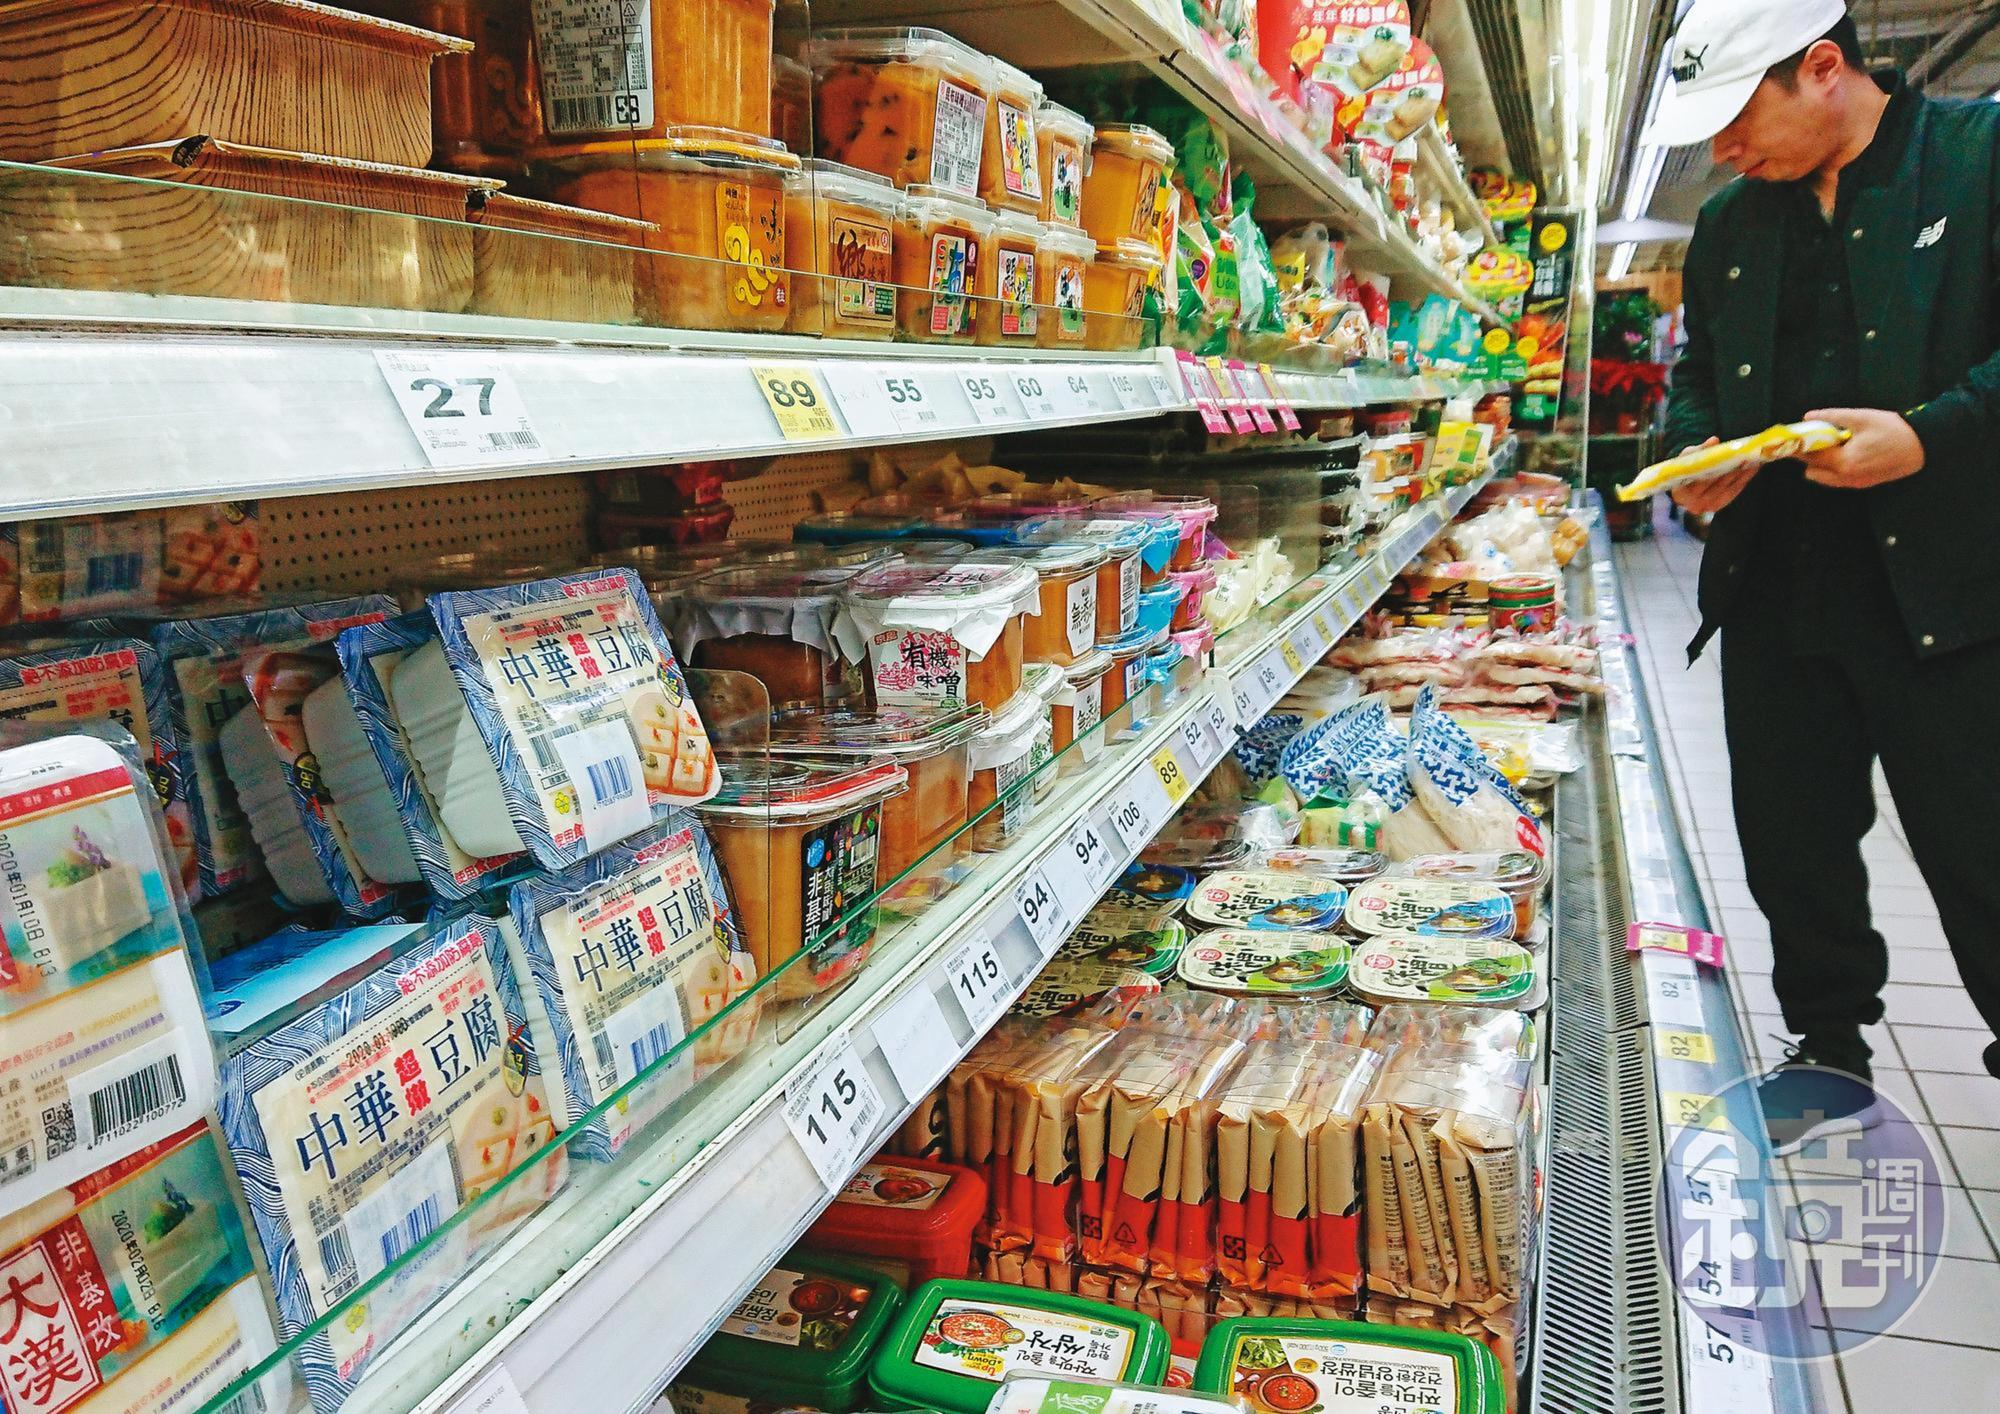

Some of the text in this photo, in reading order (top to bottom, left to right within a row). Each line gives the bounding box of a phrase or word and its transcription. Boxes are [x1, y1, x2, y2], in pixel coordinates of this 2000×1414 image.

[411, 377, 496, 418] 27
[767, 379, 818, 407] 89
[886, 378, 923, 403] 55
[966, 377, 996, 400] 95
[1017, 377, 1043, 398] 60
[1067, 375, 1089, 394] 64
[1112, 376, 1134, 392] 105
[588, 620, 655, 675] 豆腐
[901, 641, 951, 670] 有機
[499, 638, 579, 698] 中華
[1262, 667, 1276, 684] 36
[915, 671, 962, 700] 味噌
[1237, 691, 1251, 709] 31
[1212, 707, 1226, 729] 52
[1184, 722, 1202, 745] 52
[1160, 760, 1179, 785] 89
[1117, 801, 1141, 834] 106
[1075, 829, 1099, 865] 94
[656, 876, 711, 947] 豆腐
[1023, 882, 1049, 924] 94
[572, 917, 645, 992] 中華
[960, 950, 998, 999] 115
[1660, 981, 1679, 998] 82
[422, 993, 502, 1095] 豆腐
[1670, 1036, 1691, 1057] 82
[393, 1049, 432, 1117] 超嫩
[806, 1067, 857, 1145] 115
[1680, 1097, 1701, 1123] 82
[97, 1121, 139, 1146] 711022
[145, 1099, 184, 1124] 100772
[296, 1069, 400, 1180] 中華
[1686, 1174, 1713, 1207] 57
[55, 1229, 121, 1353] 非基改
[1697, 1260, 1722, 1298] 54
[0, 1271, 84, 1406] 大漢
[1026, 1330, 1086, 1355] 쌈장
[1706, 1321, 1734, 1365] 57
[981, 1365, 997, 1377] Up
[1016, 1349, 1044, 1367] 줄인
[1320, 1360, 1443, 1385] 건강한 양념쌈장
[1334, 1377, 1442, 1405] 짠맛을 줄인
